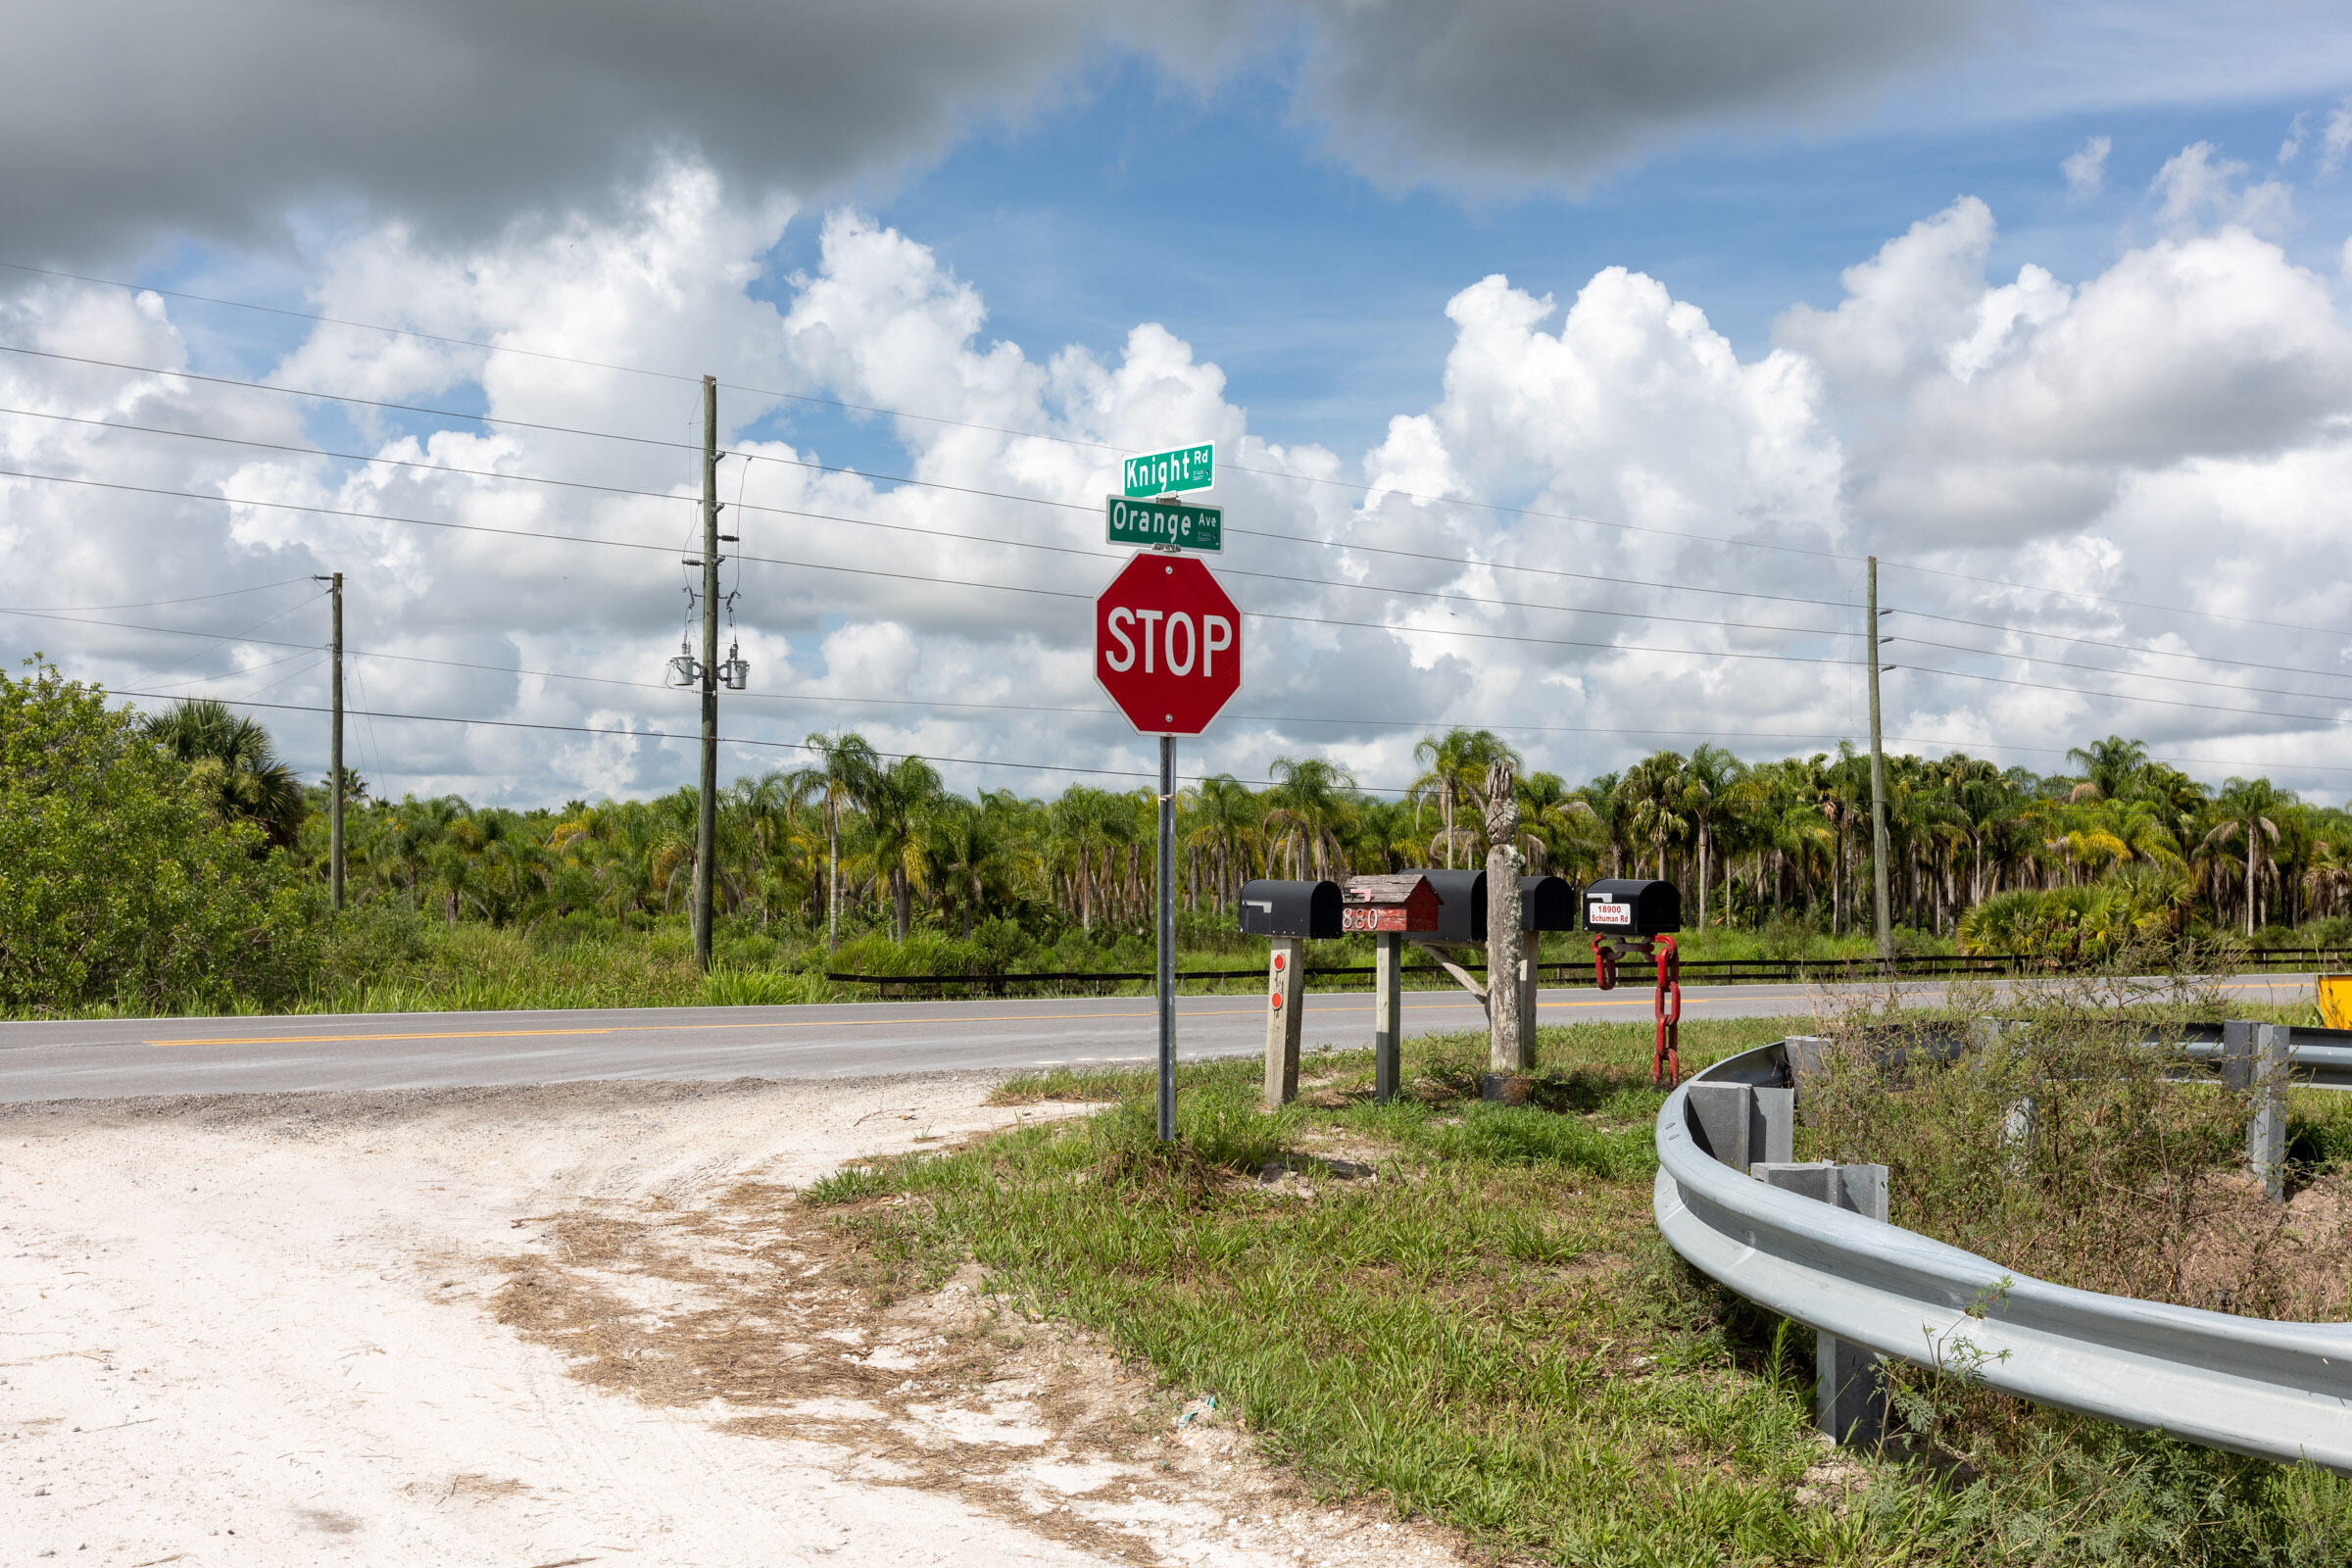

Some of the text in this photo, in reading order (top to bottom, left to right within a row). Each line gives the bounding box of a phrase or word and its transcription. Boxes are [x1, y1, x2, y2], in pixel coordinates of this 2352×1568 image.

[1127, 449, 1208, 492] Knight Rd
[1113, 502, 1216, 543] Orange Ave
[1105, 607, 1233, 677] STOP
[1343, 908, 1377, 929] 880
